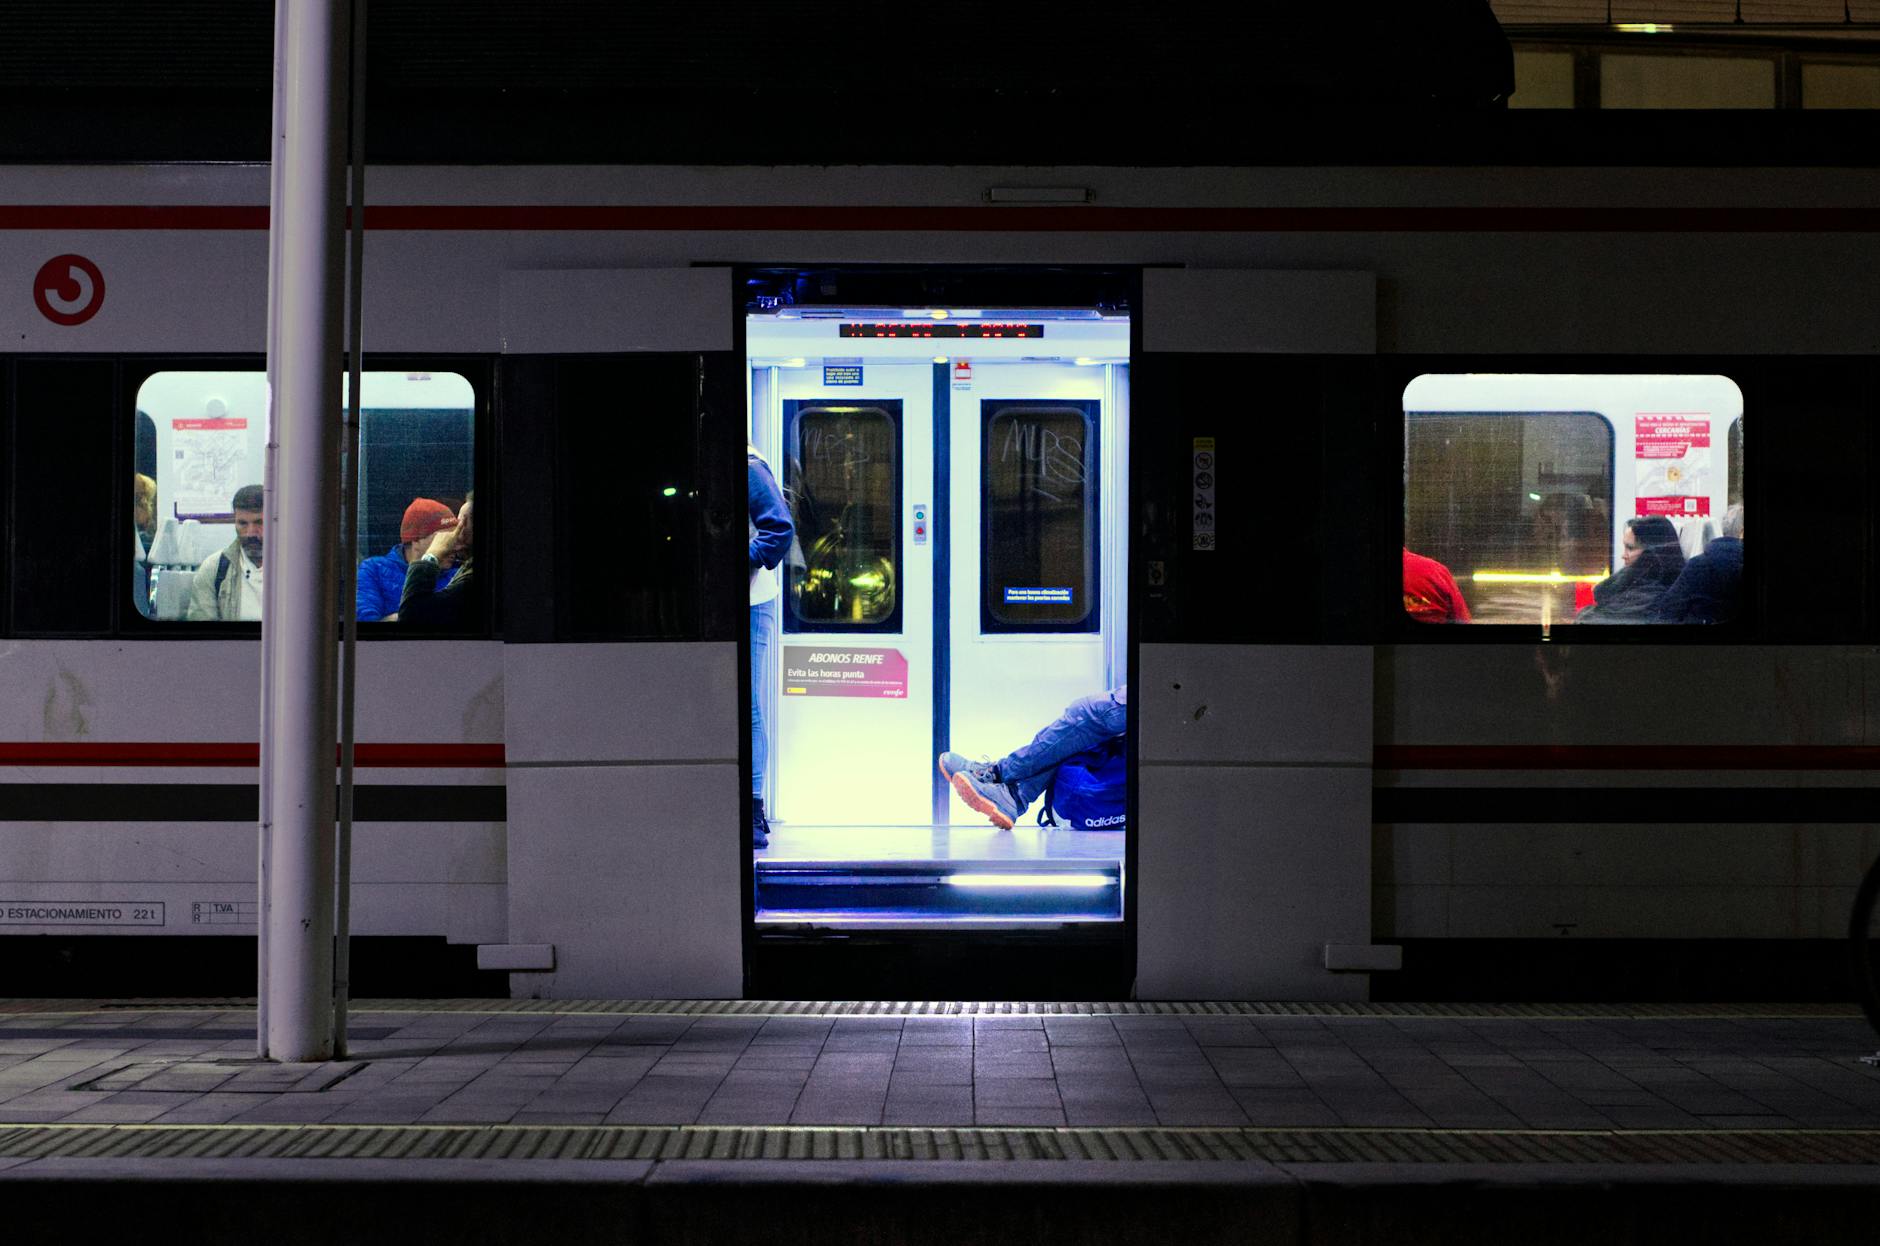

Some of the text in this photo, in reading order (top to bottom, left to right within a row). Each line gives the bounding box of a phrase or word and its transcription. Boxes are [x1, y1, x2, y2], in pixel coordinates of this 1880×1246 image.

[808, 653, 884, 665] ABONOS RENFE
[787, 668, 865, 679] Evita las horas punta
[1084, 814, 1126, 828] adidas
[8, 908, 122, 919] ESTACIONAMIENTO
